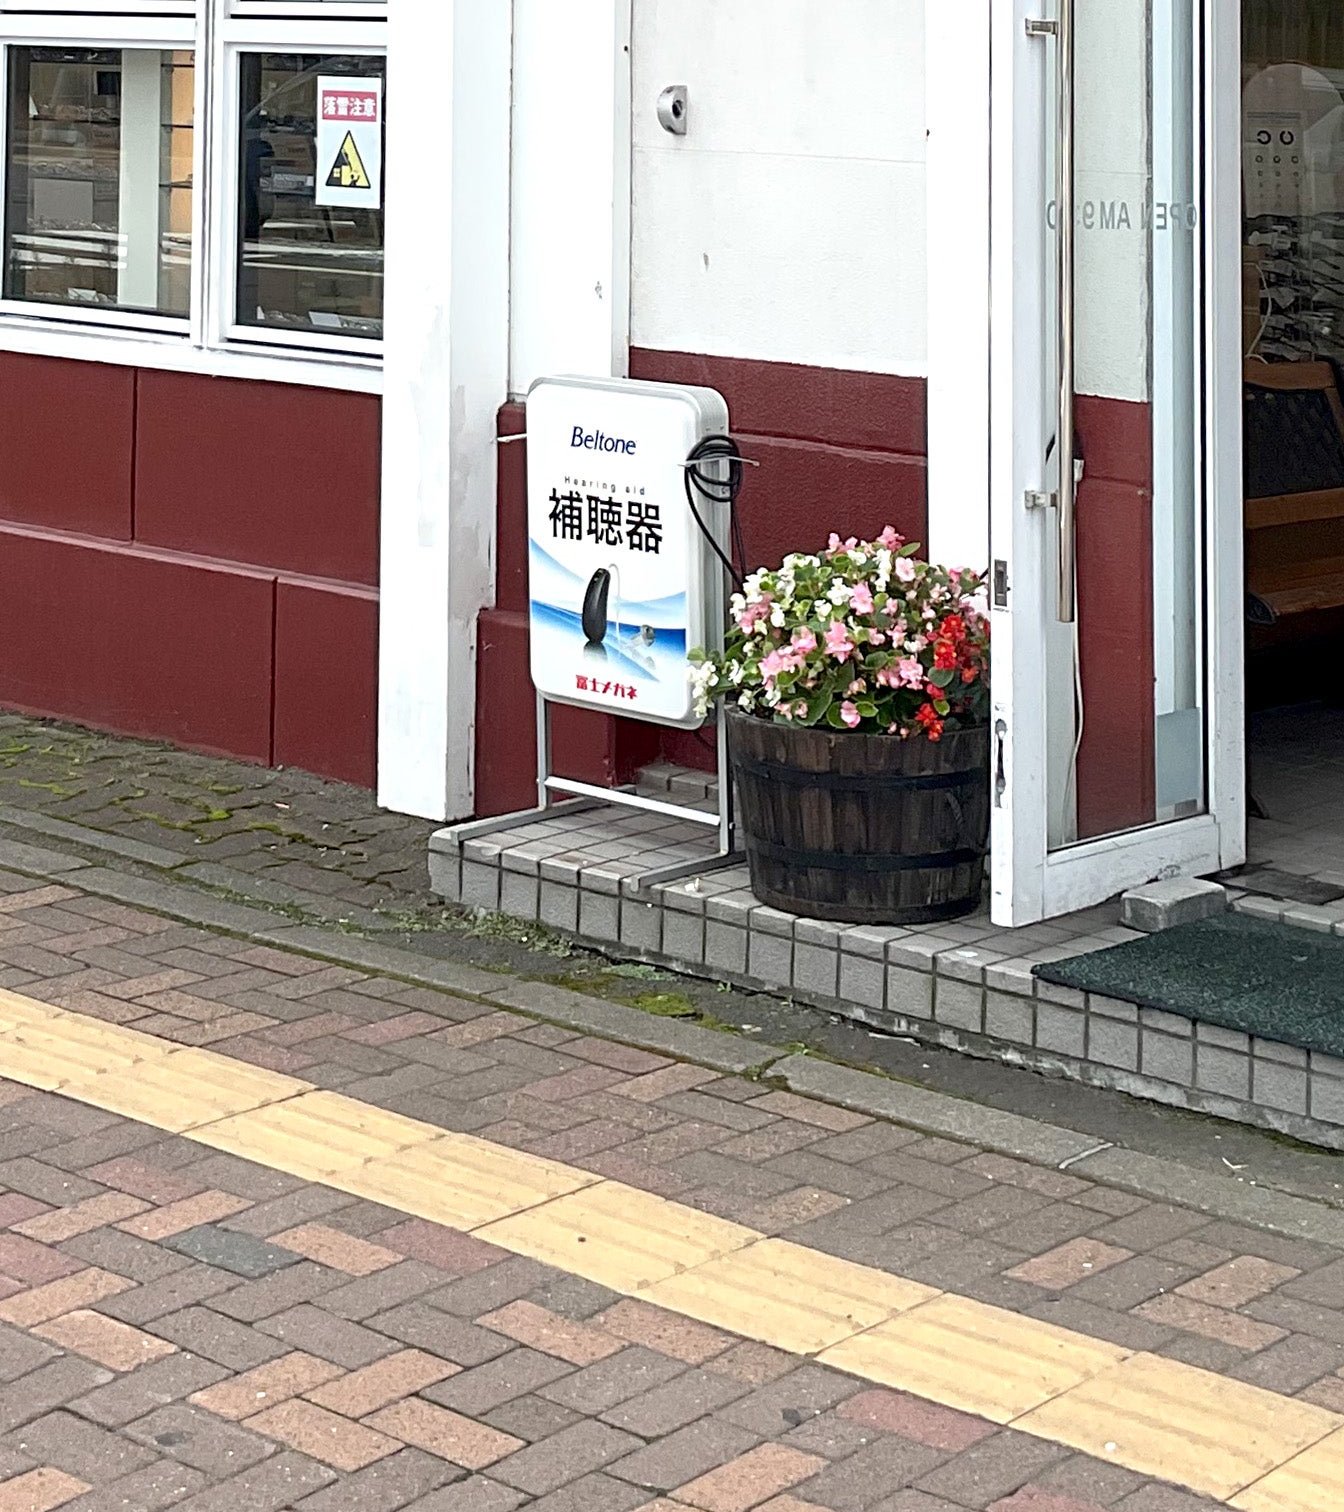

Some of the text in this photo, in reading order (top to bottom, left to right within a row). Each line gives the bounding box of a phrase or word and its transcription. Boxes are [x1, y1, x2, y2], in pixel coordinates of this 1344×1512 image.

[570, 425, 637, 455] Beltone
[564, 476, 645, 496] Hearing aid
[548, 487, 663, 555] 補聴器
